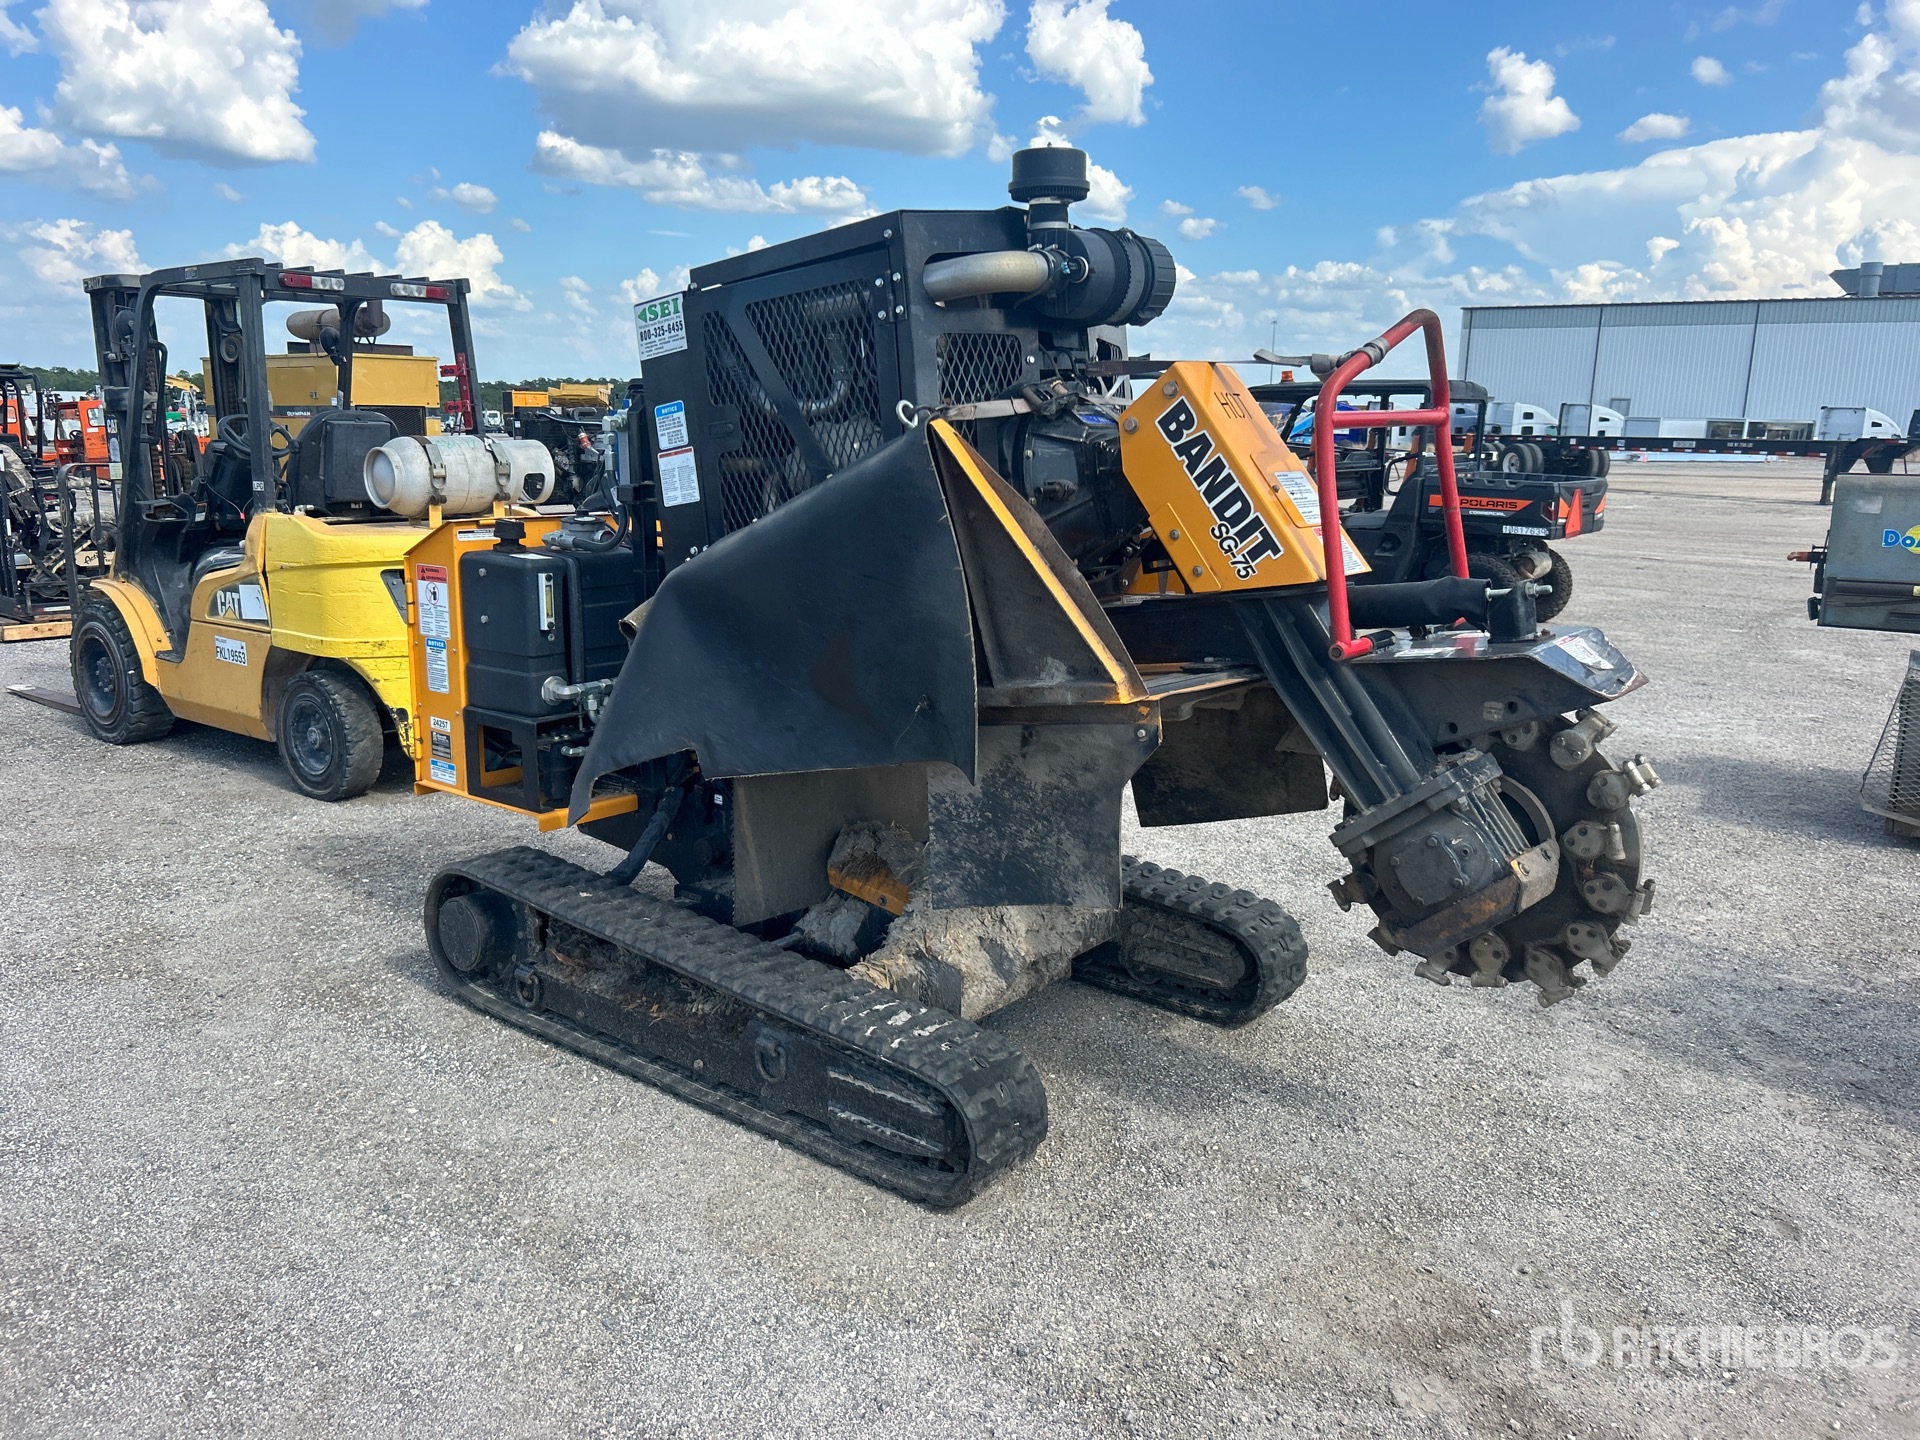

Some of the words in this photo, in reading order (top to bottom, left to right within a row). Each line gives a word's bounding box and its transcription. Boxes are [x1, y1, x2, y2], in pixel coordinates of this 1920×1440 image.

[647, 297, 681, 322] SEI
[639, 320, 684, 342] 800-325-6455
[661, 405, 678, 415] NOTICE
[106, 418, 118, 434] CAT
[253, 482, 264, 490] LPG
[1156, 397, 1283, 565] BANDIT
[1460, 498, 1518, 509] POLARIS
[1210, 522, 1257, 580] SG-75
[216, 590, 240, 619] CAT
[427, 640, 444, 648] NOTICE
[215, 645, 246, 665] FKL19553
